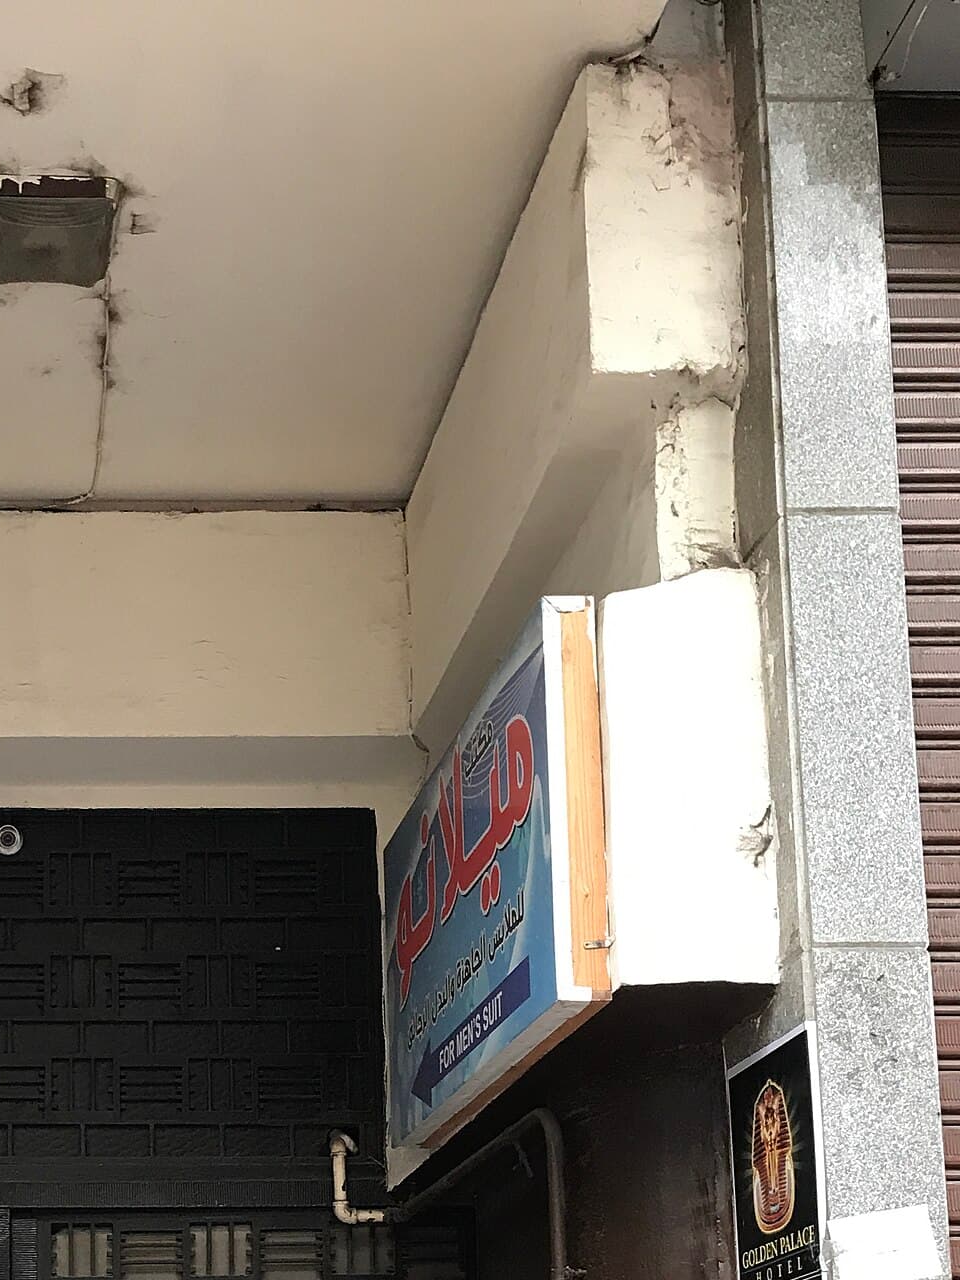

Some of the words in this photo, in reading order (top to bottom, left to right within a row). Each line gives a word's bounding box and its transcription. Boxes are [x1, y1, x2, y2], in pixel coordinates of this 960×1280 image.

[396, 714, 534, 1013] ميلانو
[456, 928, 486, 994] الجاهزة
[488, 884, 525, 963] للملابس
[439, 1040, 455, 1073] FOR
[456, 1014, 481, 1055] MEN'S
[483, 991, 503, 1033] SUIT
[742, 1239, 779, 1269] GOLDEN
[780, 1224, 816, 1256] PALACE
